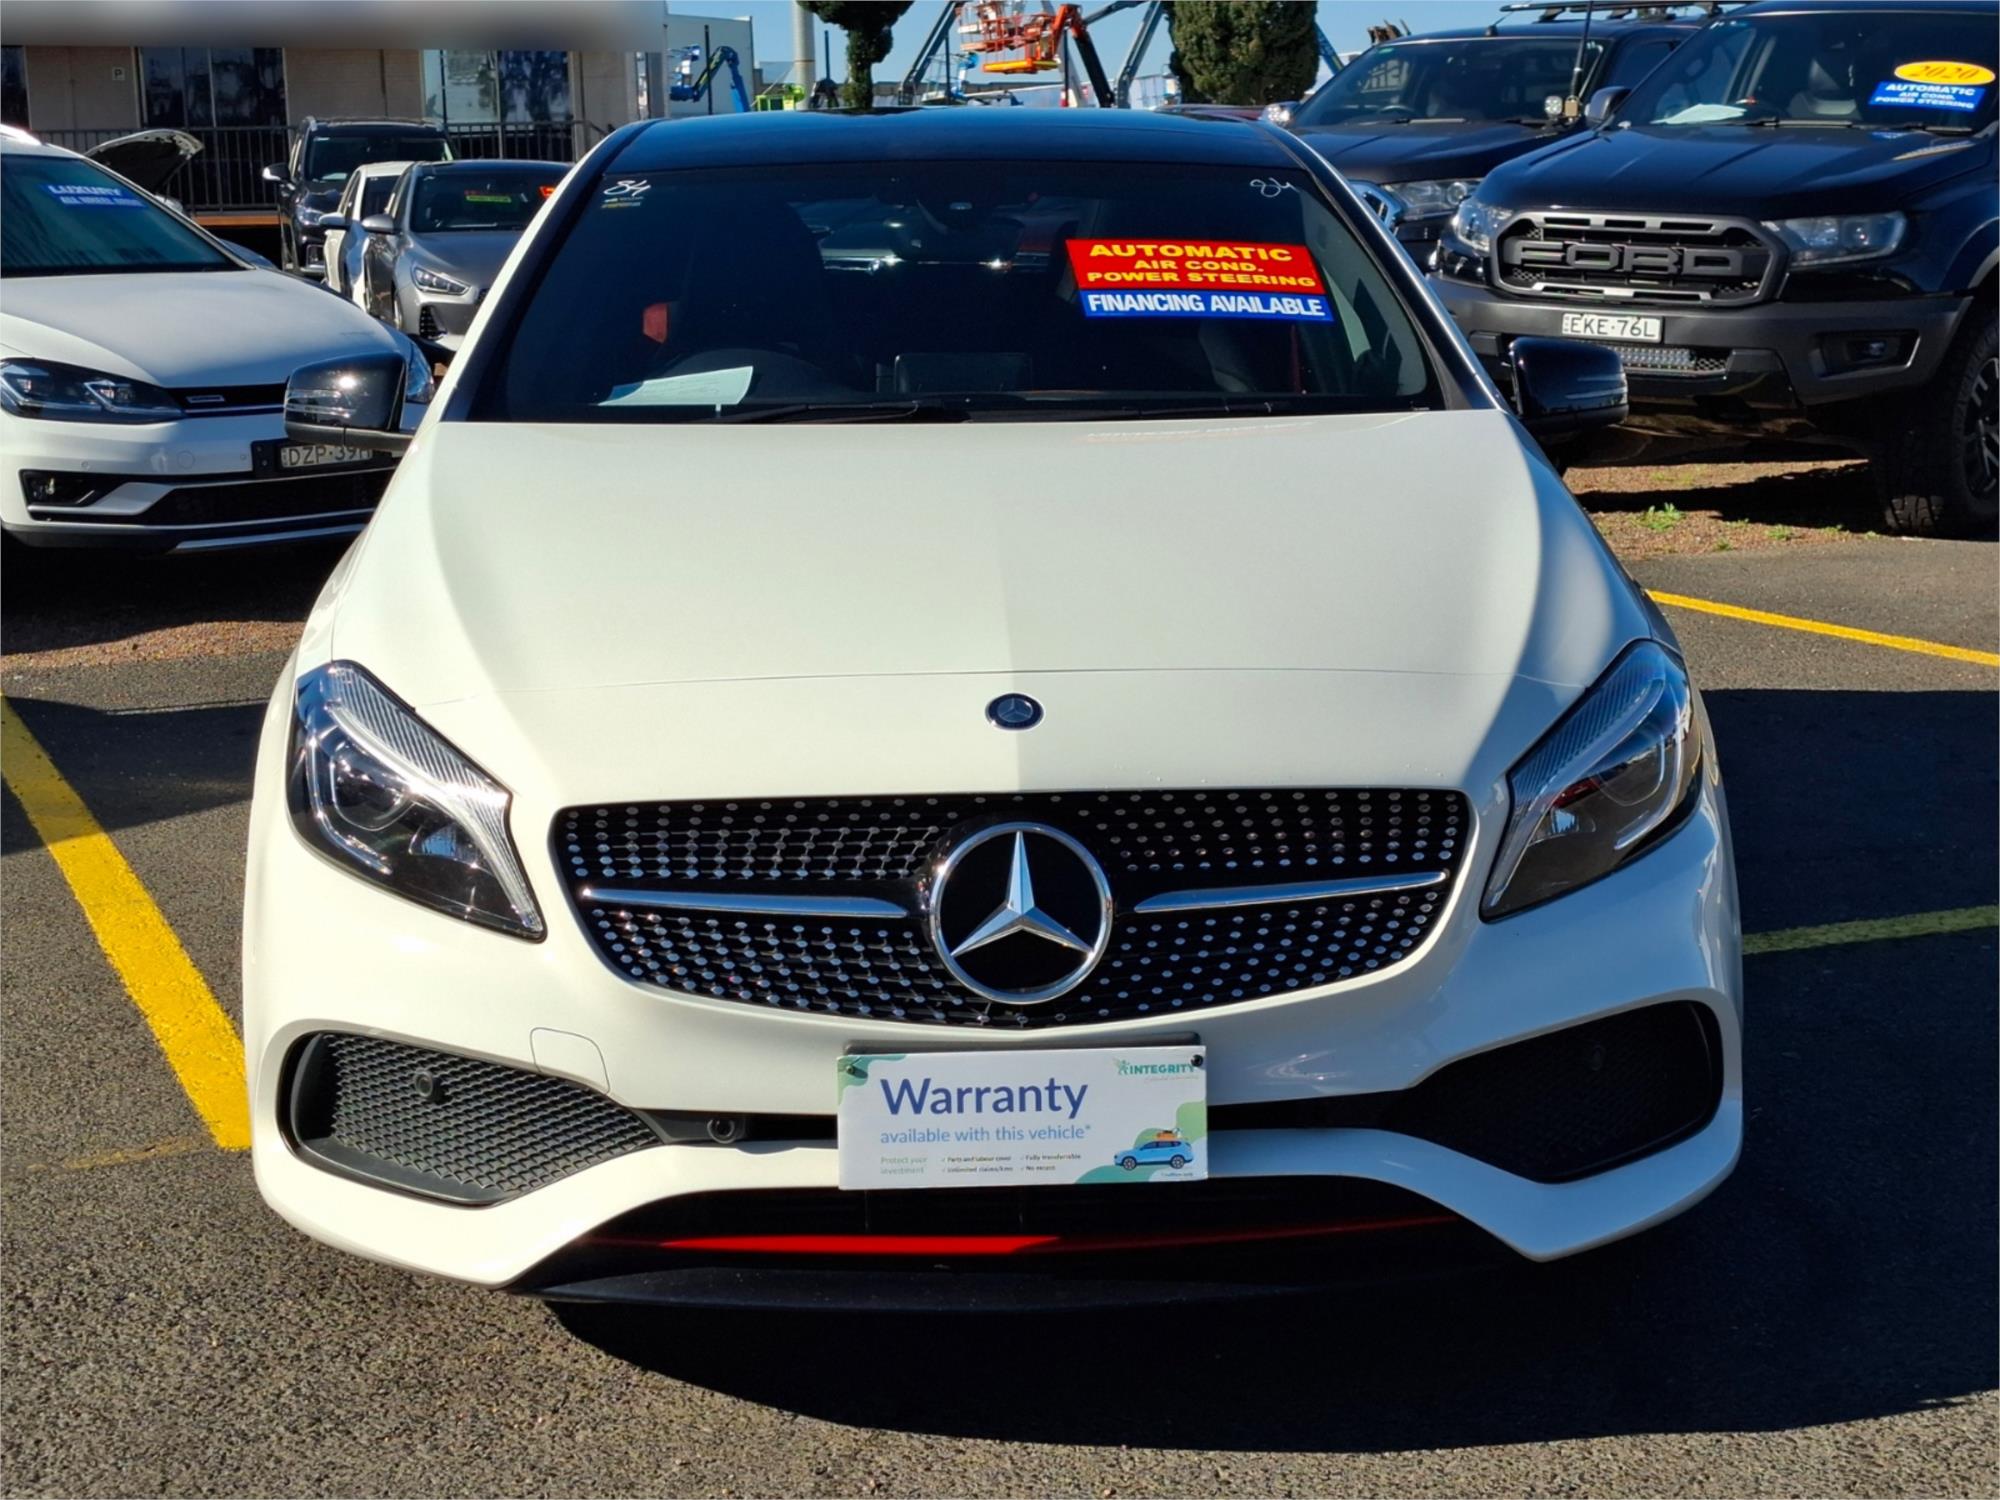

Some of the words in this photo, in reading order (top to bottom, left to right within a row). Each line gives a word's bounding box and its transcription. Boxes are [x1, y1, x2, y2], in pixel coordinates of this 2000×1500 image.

[114, 68, 122, 79] P
[1885, 83, 1976, 95] AUTOMATIC
[1917, 98, 1975, 108] STEERING
[1089, 244, 1293, 261] AUTOMATIC
[1504, 240, 1741, 276] FORD
[1134, 260, 1178, 270] AIR
[1185, 261, 1265, 272] COND.
[1087, 272, 1180, 283] POWER
[1187, 273, 1316, 287] STEERING
[1088, 294, 1204, 312] FINANCING
[1210, 295, 1326, 317] AVAILABLE
[1130, 1064, 1194, 1074] INTEGRITY
[880, 1078, 1088, 1119] Warranty
[880, 1128, 950, 1143] available
[954, 1127, 990, 1141] with
[995, 1126, 1024, 1140] this
